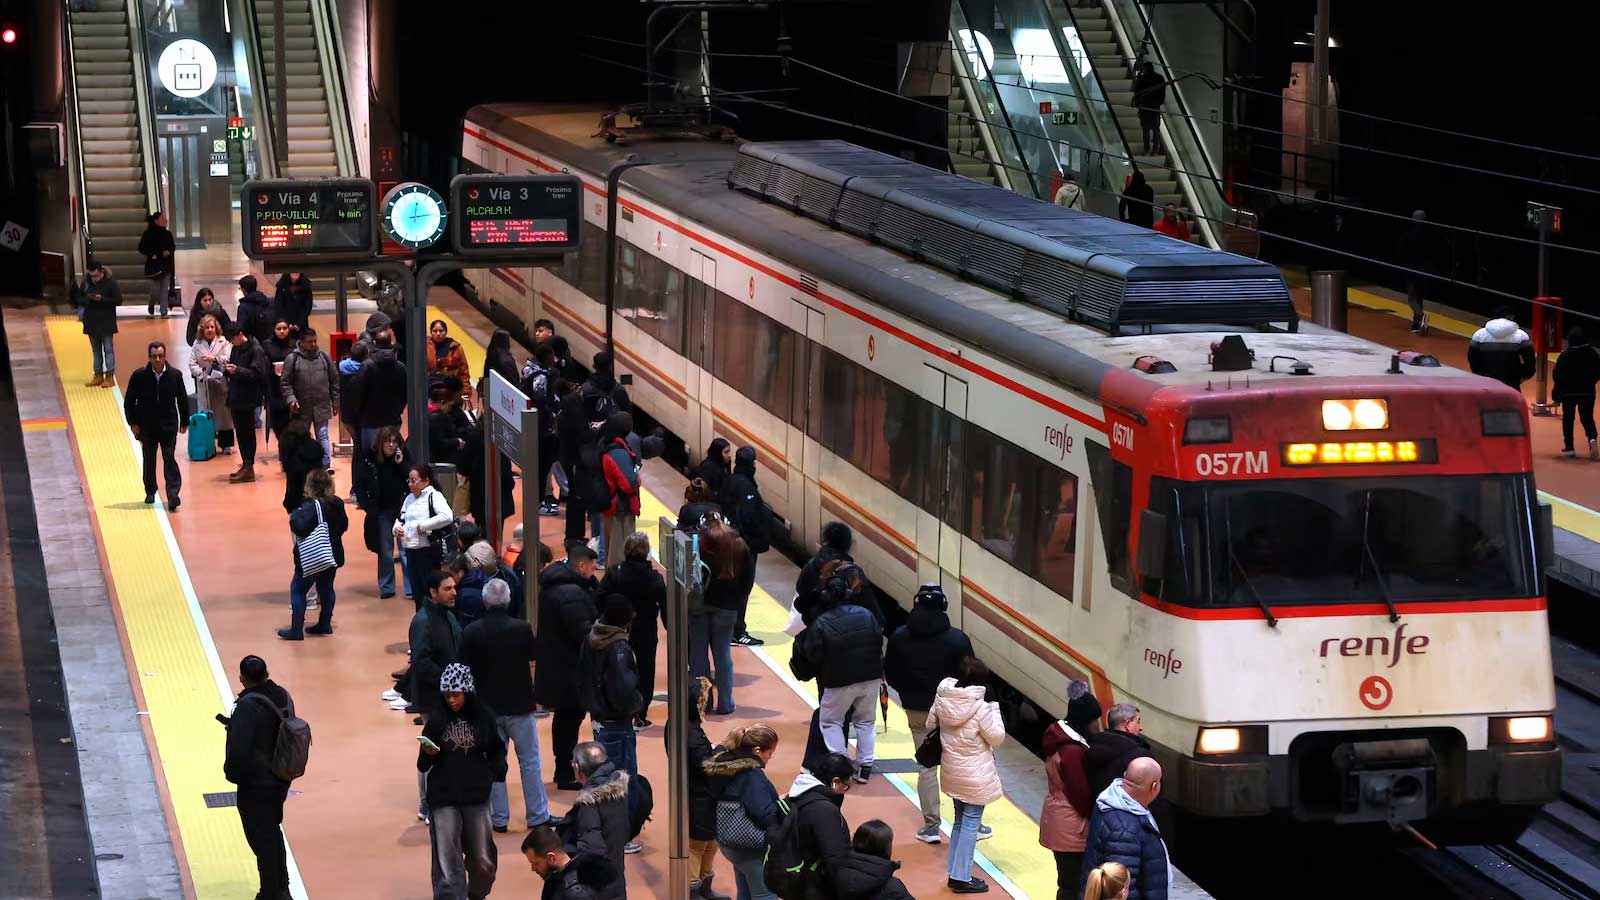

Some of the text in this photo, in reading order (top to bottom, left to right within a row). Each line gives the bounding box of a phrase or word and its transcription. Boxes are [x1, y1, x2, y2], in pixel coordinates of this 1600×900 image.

[278, 191, 318, 205] Vía 4
[489, 187, 528, 200] Vía 3
[338, 209, 345, 219] 4
[346, 210, 362, 219] min
[466, 206, 502, 216] ALCALA
[5, 227, 20, 244] 30
[1044, 423, 1073, 462] renfe
[1112, 421, 1134, 452] 057M
[1195, 450, 1269, 476] 057M
[1320, 623, 1430, 668] renfe
[1144, 647, 1183, 679] renfe
